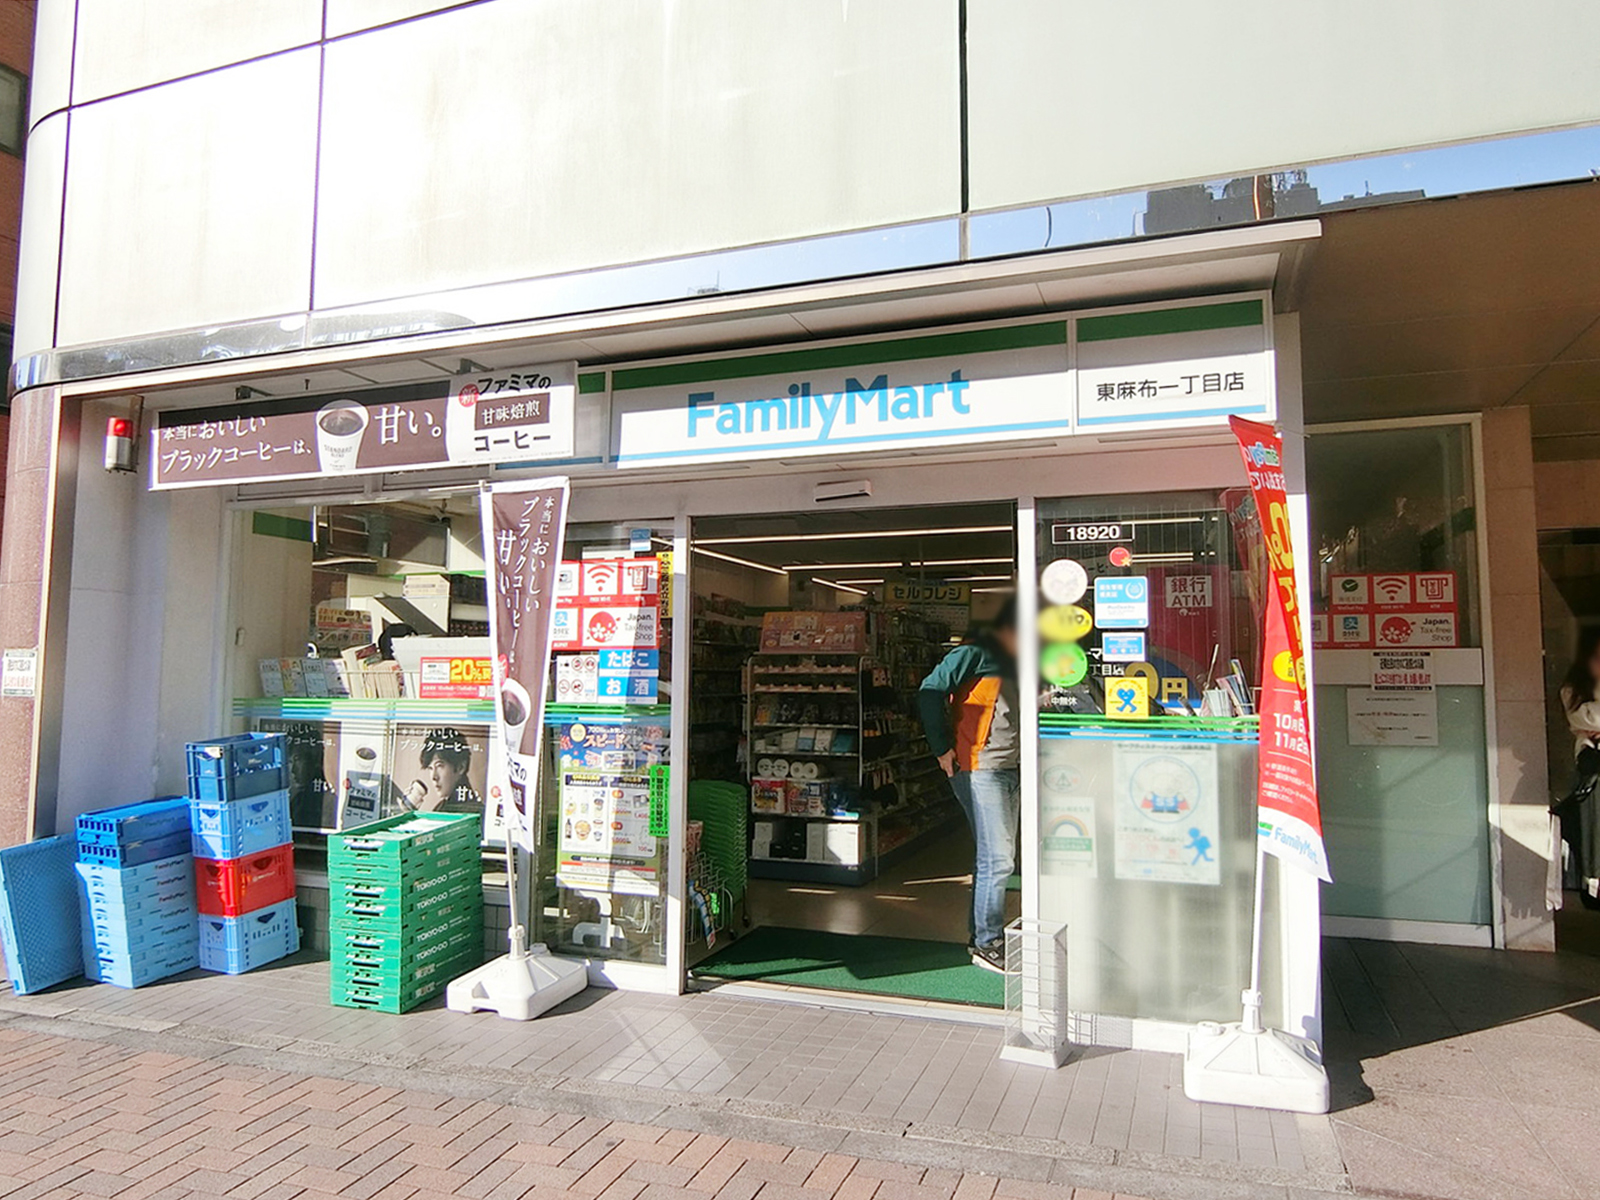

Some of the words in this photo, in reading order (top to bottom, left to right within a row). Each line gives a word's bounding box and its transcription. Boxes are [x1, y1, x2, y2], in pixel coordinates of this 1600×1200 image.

[477, 373, 552, 396] ファミマの
[1096, 371, 1245, 402] 東麻布一丁目店
[481, 400, 541, 426] 甘味焙煎
[687, 369, 970, 441] FamilyMart
[162, 415, 266, 442] 本当においしい
[374, 404, 443, 445] 甘い。
[474, 431, 551, 452] コーヒー
[162, 439, 313, 475] ブラックコーヒーは、
[1067, 525, 1121, 541] 18920
[525, 496, 555, 613] 本当においしい
[496, 529, 517, 610] 甘い。
[1171, 576, 1207, 594] 銀行
[1171, 594, 1207, 607] ATM
[1422, 618, 1450, 626] Japan.
[635, 632, 654, 641] Shop
[606, 651, 650, 668] たばこ
[455, 785, 482, 803] 甘い。
[345, 808, 374, 821] コーヒー
